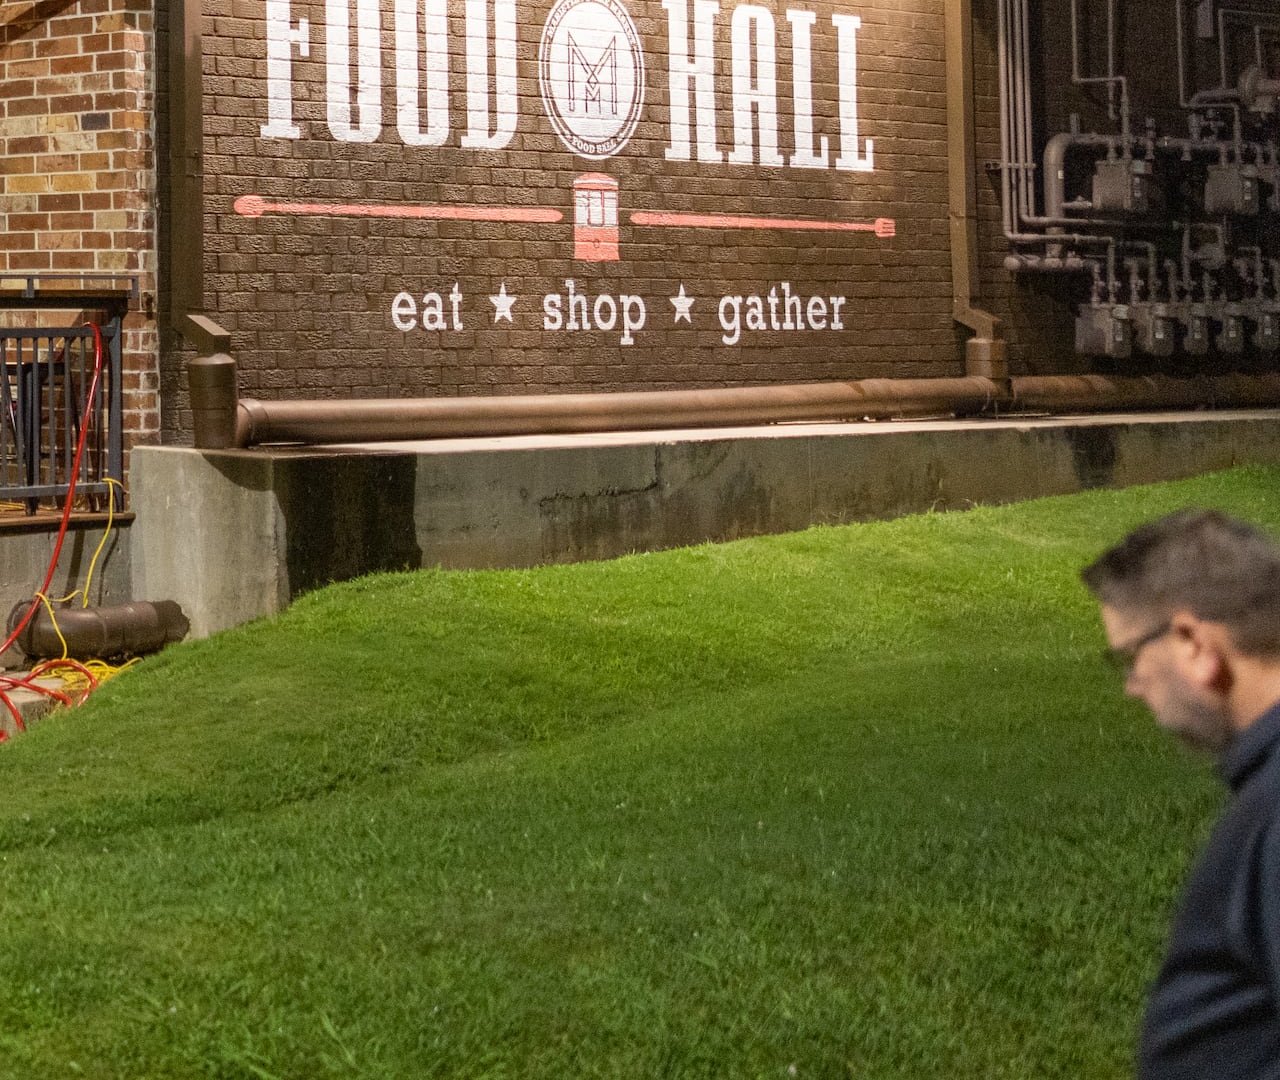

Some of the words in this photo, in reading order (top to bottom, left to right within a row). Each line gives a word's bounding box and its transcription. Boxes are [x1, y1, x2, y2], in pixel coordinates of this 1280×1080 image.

[391, 283, 464, 332] eat
[543, 280, 646, 345] shop
[718, 282, 845, 345] gather
